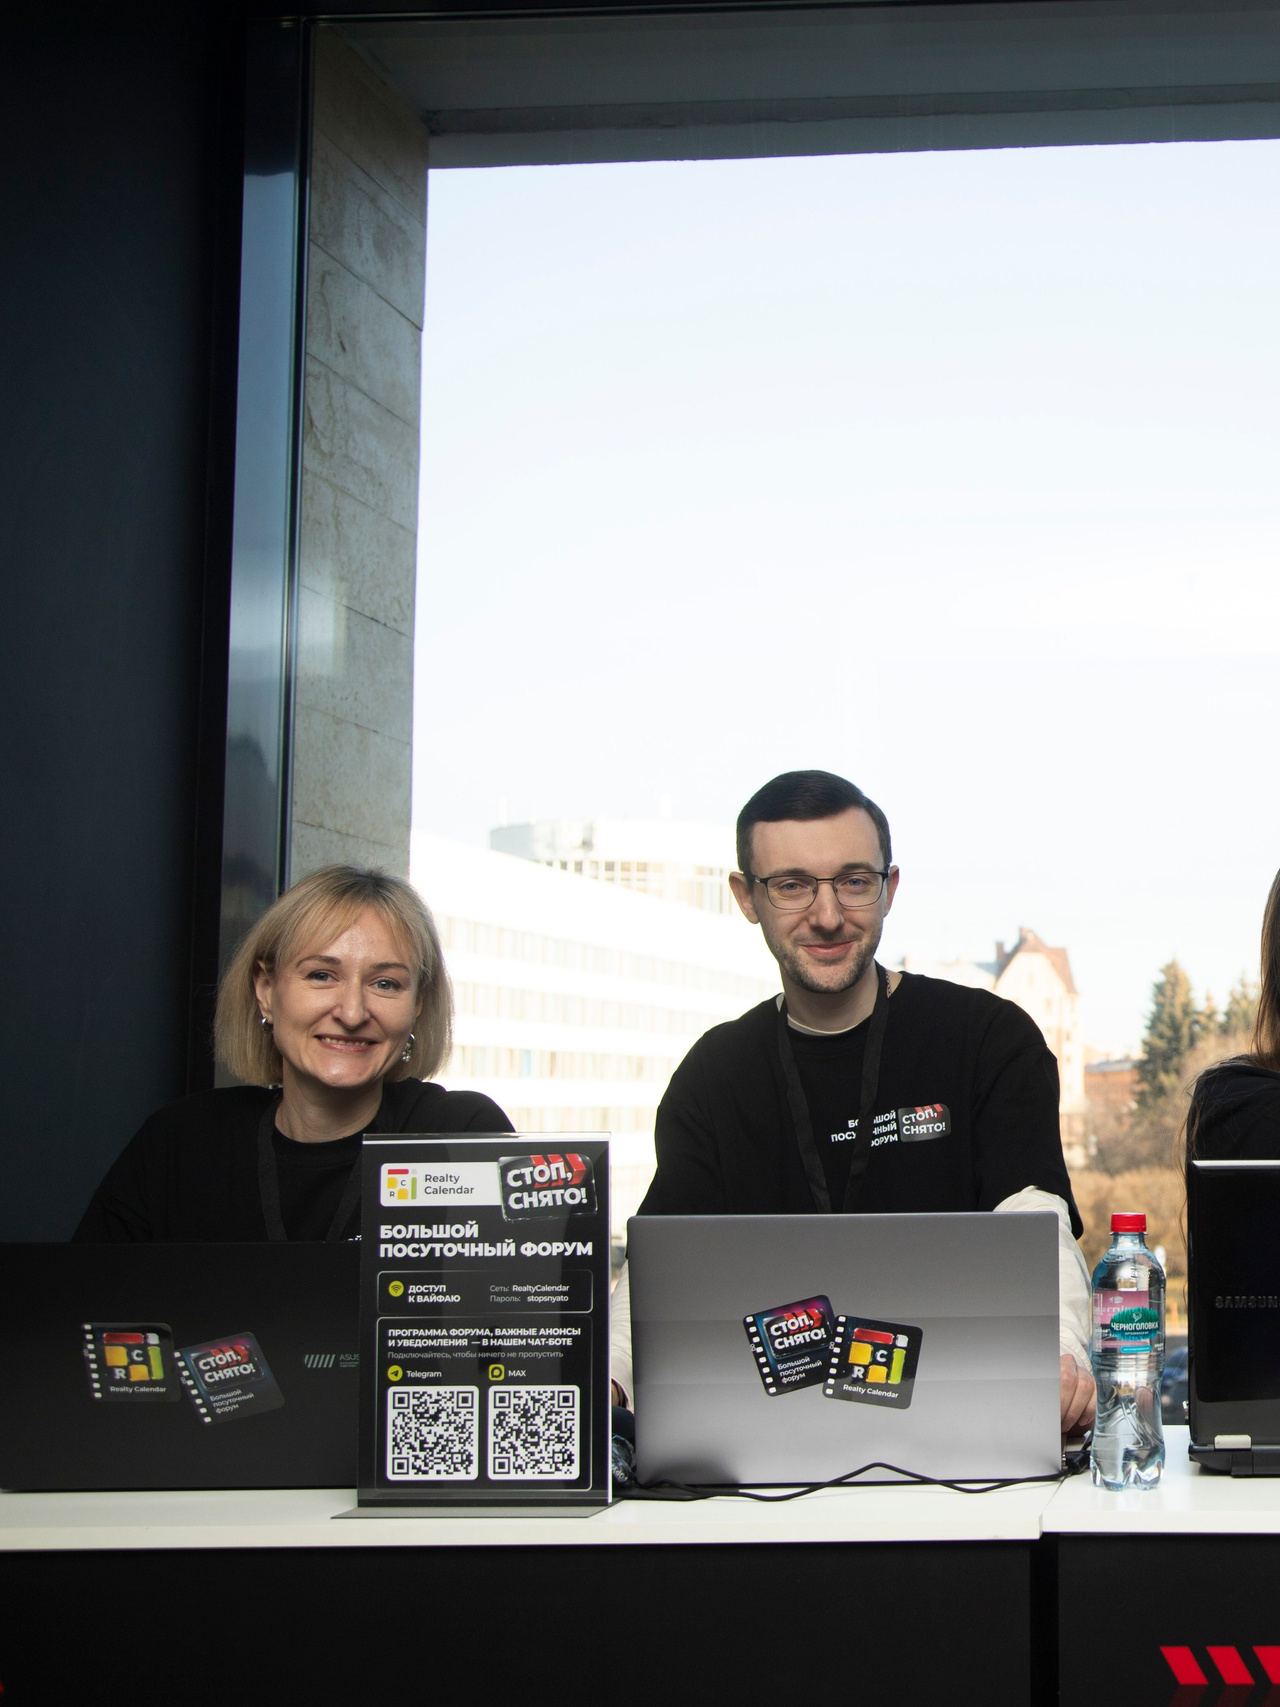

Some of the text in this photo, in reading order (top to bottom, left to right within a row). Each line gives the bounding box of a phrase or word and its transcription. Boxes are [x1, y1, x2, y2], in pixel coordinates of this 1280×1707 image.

[902, 1109, 938, 1124] СТОП,
[902, 1122, 946, 1135] СНЯТО!
[424, 1173, 460, 1185] Realty
[506, 1162, 573, 1188] СТОП,
[424, 1185, 475, 1196] Calendar
[508, 1187, 588, 1210] СНЯТО!
[379, 1221, 479, 1239] БОЛЬШОЙ
[379, 1239, 593, 1258] ПОСУТОЧНЫЙ ФОРУМ
[408, 1285, 446, 1295] ДОСТУП
[512, 1284, 570, 1294] RealtyCalendar
[408, 1293, 461, 1303] К ВАЙФАЮ
[527, 1294, 569, 1305] stopsnyato
[388, 1327, 581, 1337] ПРОГРАММА ФОРУМА, ВАЖНЫЕ АНОНСЫ
[770, 1315, 814, 1336] СТОП,
[1111, 1322, 1159, 1331] ЧЕРНОГОЛОВКА
[388, 1339, 396, 1347] И
[397, 1338, 468, 1348] УВЕДОМЛЕНИЯ
[482, 1338, 489, 1346] В
[490, 1338, 527, 1346] НАШЕМ
[527, 1338, 573, 1346] ЧАТ-БОТЕ
[774, 1329, 827, 1350] СНЯТО!
[199, 1351, 242, 1370] СТОП,
[388, 1351, 452, 1359] Подключайтесь,
[777, 1356, 811, 1370] Большой
[779, 1360, 822, 1377] посуточный
[204, 1363, 256, 1382] СНЯТО!
[406, 1370, 442, 1379] Telegram
[781, 1372, 806, 1384] форум
[843, 1384, 899, 1399] Realty Calendar
